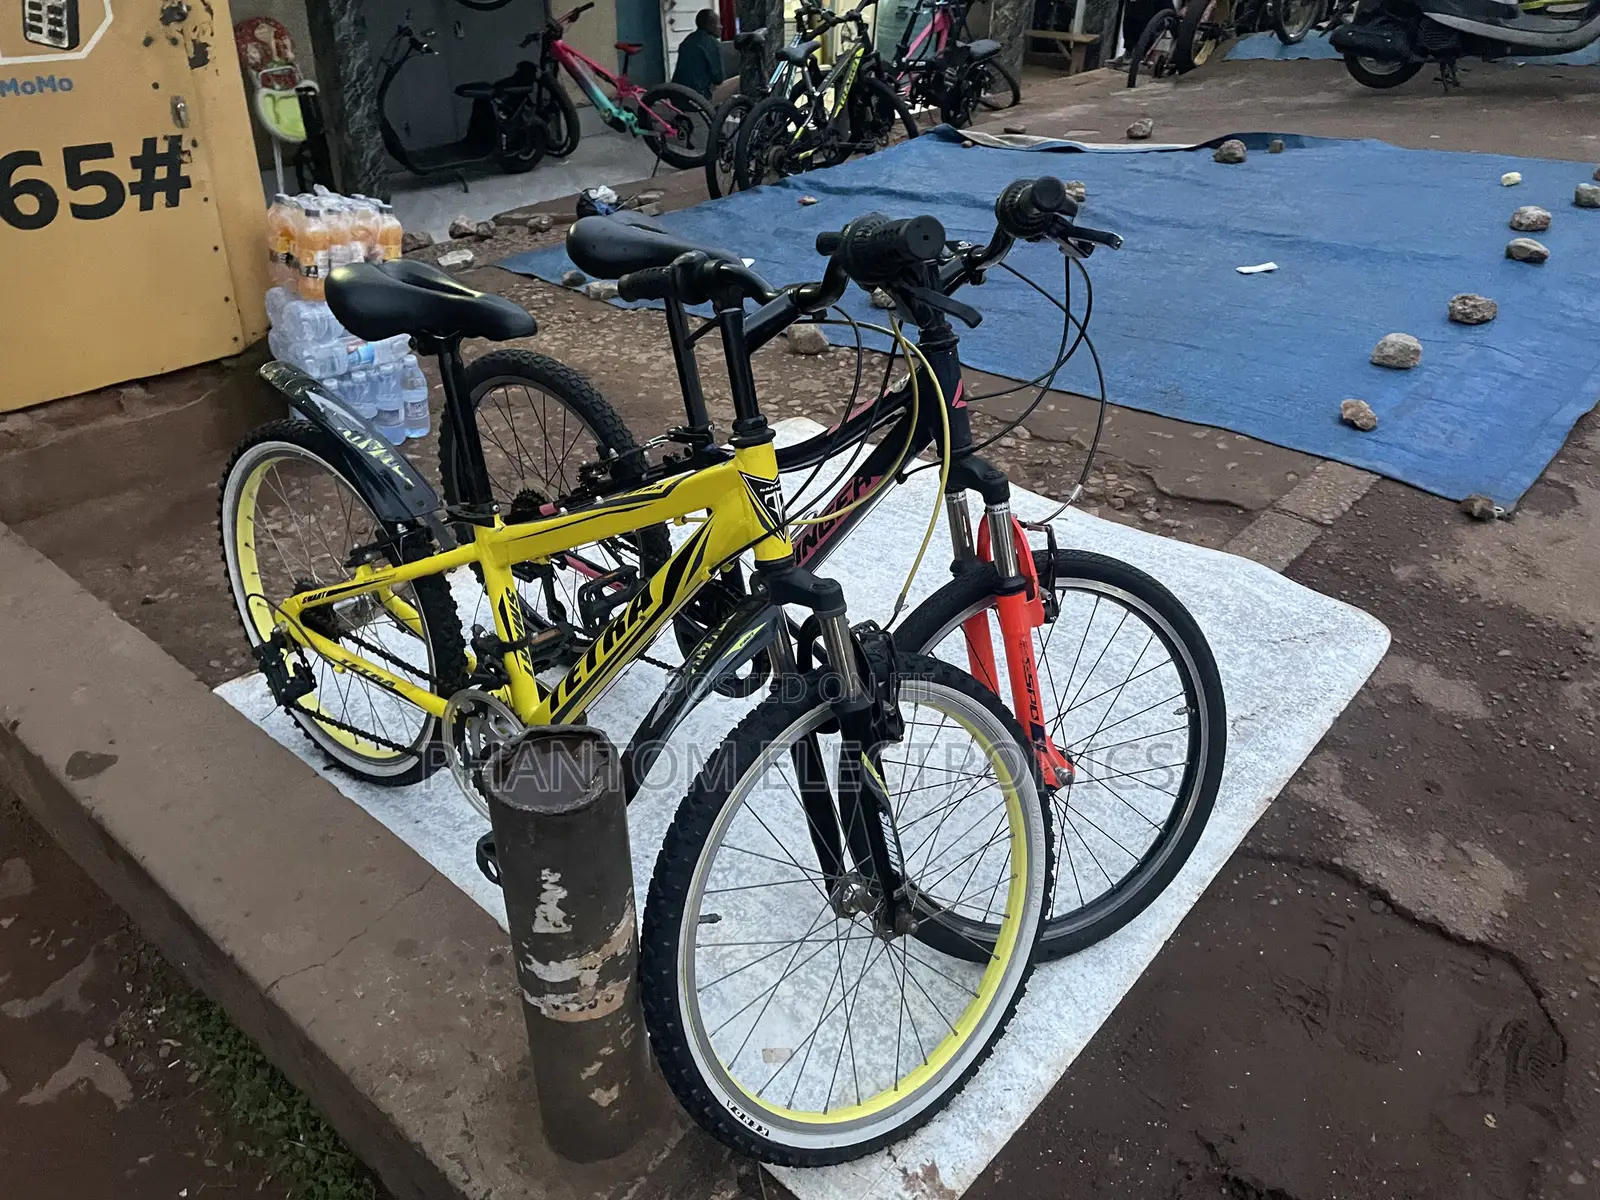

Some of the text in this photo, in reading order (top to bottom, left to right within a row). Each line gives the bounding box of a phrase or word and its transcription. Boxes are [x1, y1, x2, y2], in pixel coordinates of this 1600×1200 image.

[0, 74, 73, 97] MoMo
[0, 135, 192, 230] 65#
[727, 1099, 770, 1137] KENDA
